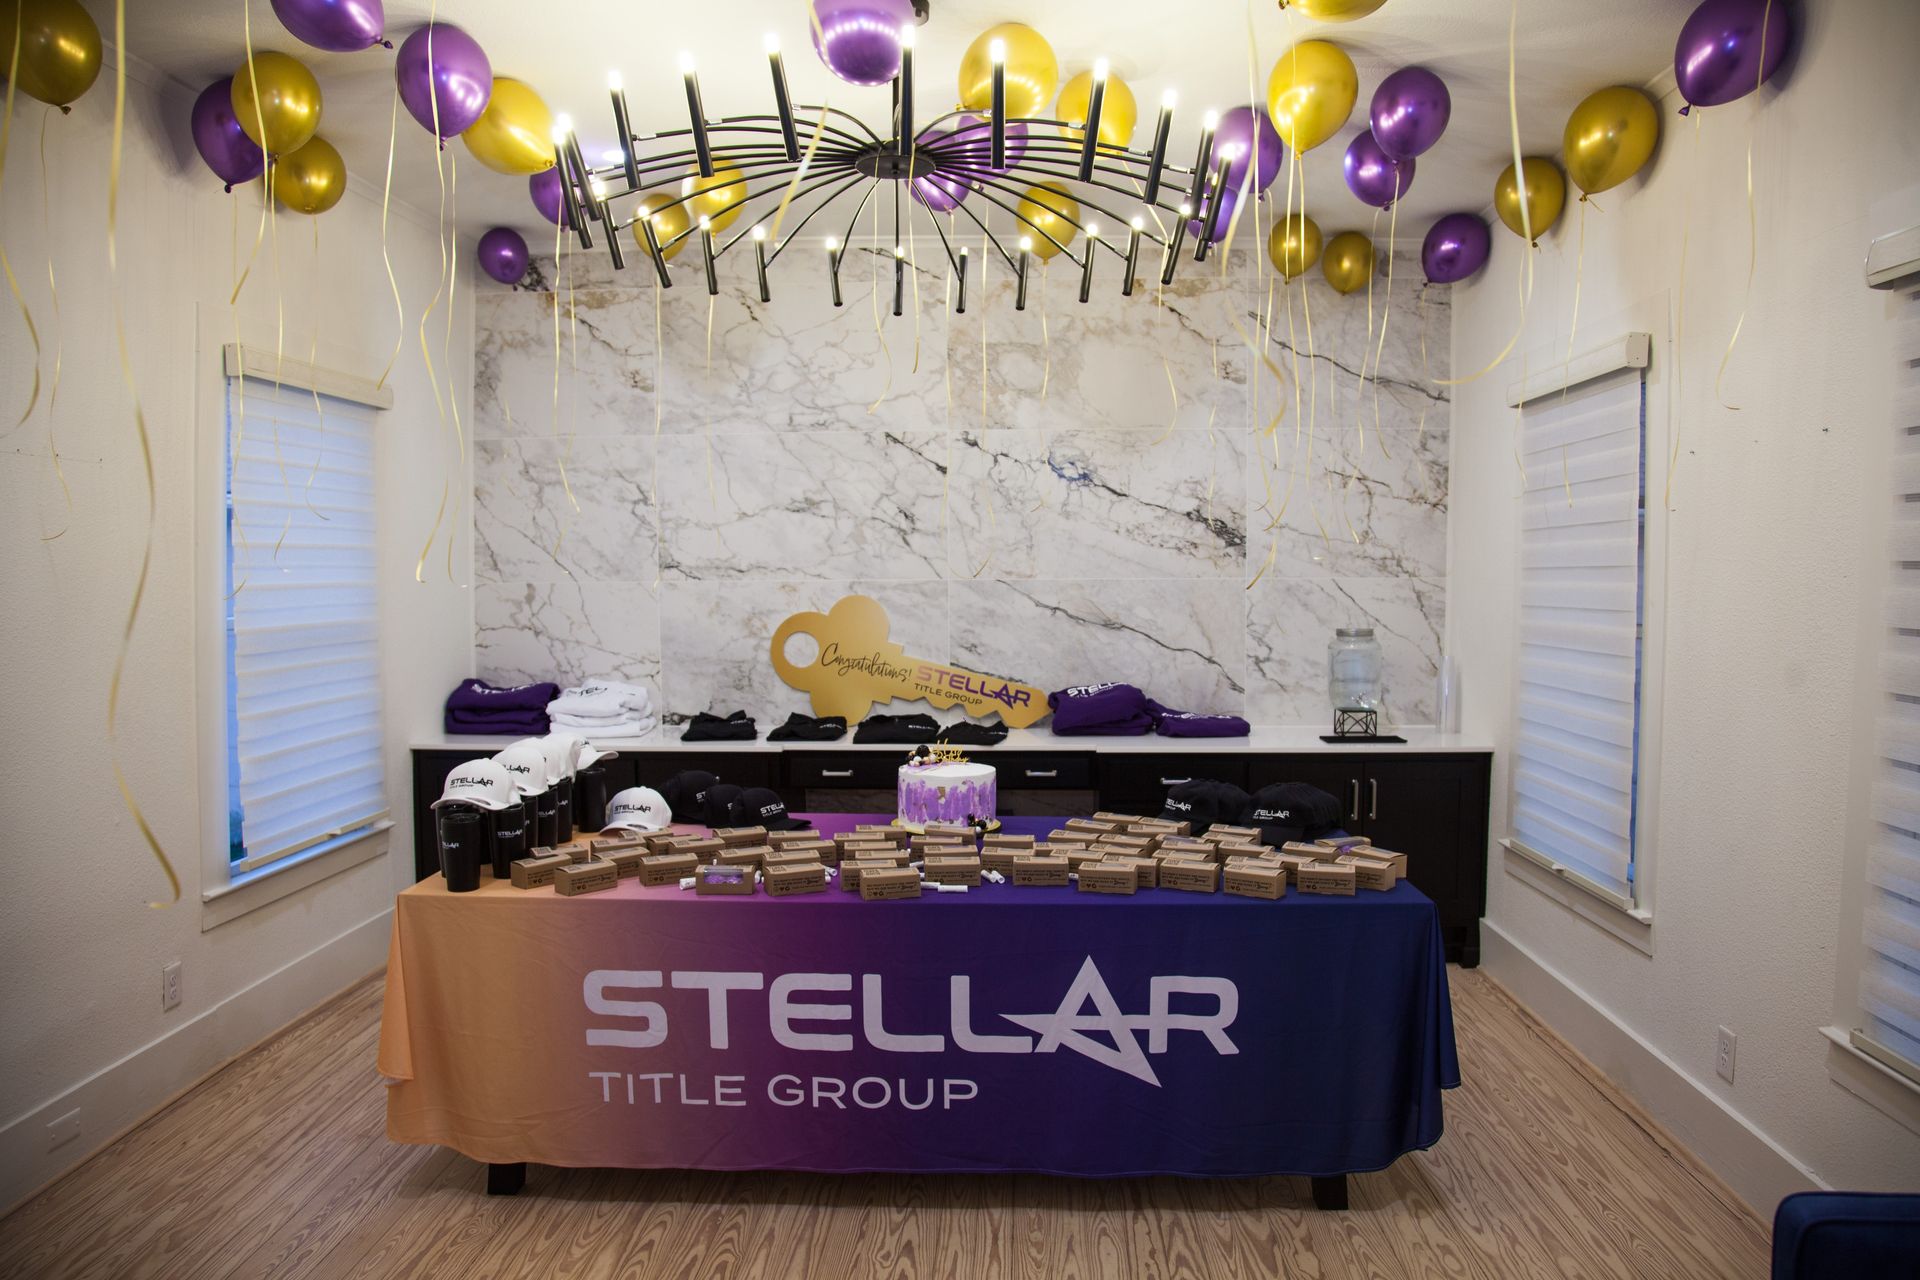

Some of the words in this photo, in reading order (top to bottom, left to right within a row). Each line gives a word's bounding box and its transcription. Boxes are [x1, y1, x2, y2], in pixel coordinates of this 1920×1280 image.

[821, 642, 912, 682] Congratulations!
[914, 682, 942, 697] TITLE
[944, 690, 983, 705] GROUP
[916, 664, 1031, 710] STELLAR
[450, 777, 494, 787] STELLAR
[614, 804, 652, 813] STELLAR
[582, 954, 1241, 1088] STELLAR
[588, 1071, 747, 1107] TITLE
[766, 1073, 979, 1111] GROUP
